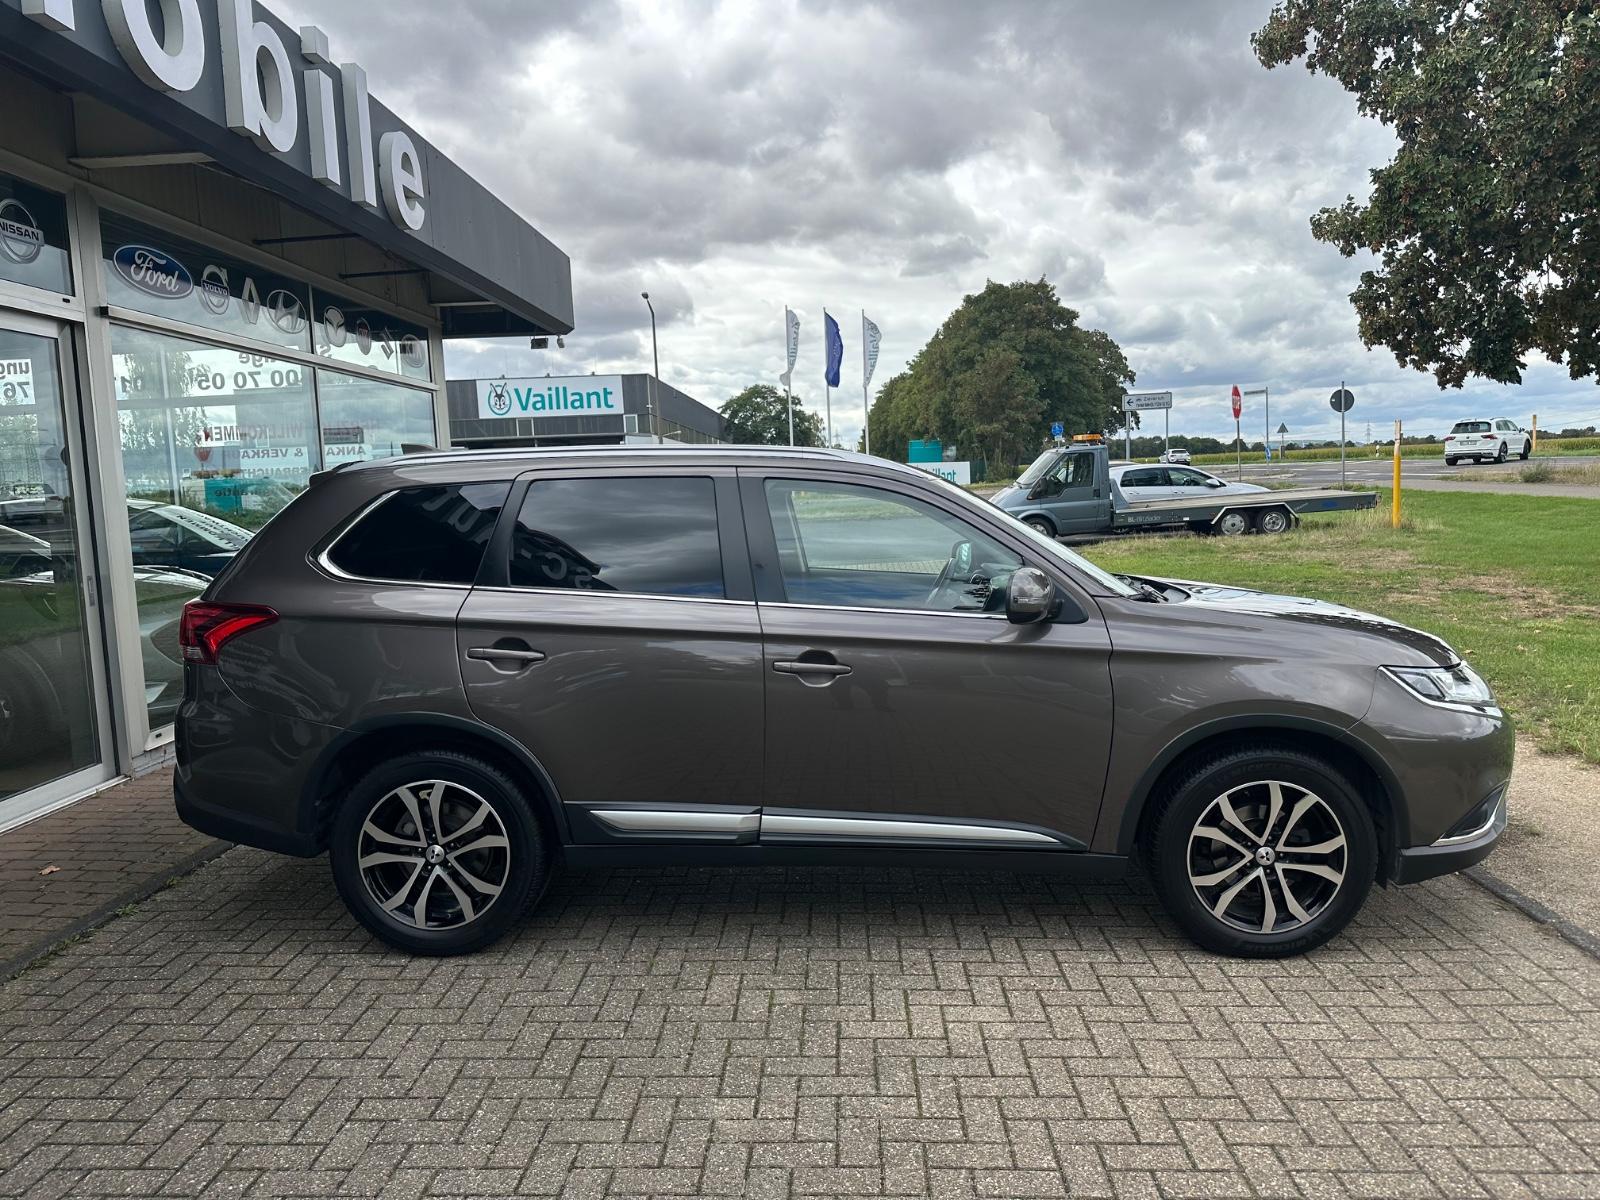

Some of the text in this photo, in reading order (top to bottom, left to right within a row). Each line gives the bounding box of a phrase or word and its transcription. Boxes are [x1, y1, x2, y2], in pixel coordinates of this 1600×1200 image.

[22, 0, 426, 232] obile
[0, 221, 39, 241] NISSAN
[130, 250, 179, 292] Ford
[203, 281, 228, 296] VOLVO
[514, 386, 614, 411] Vaillant
